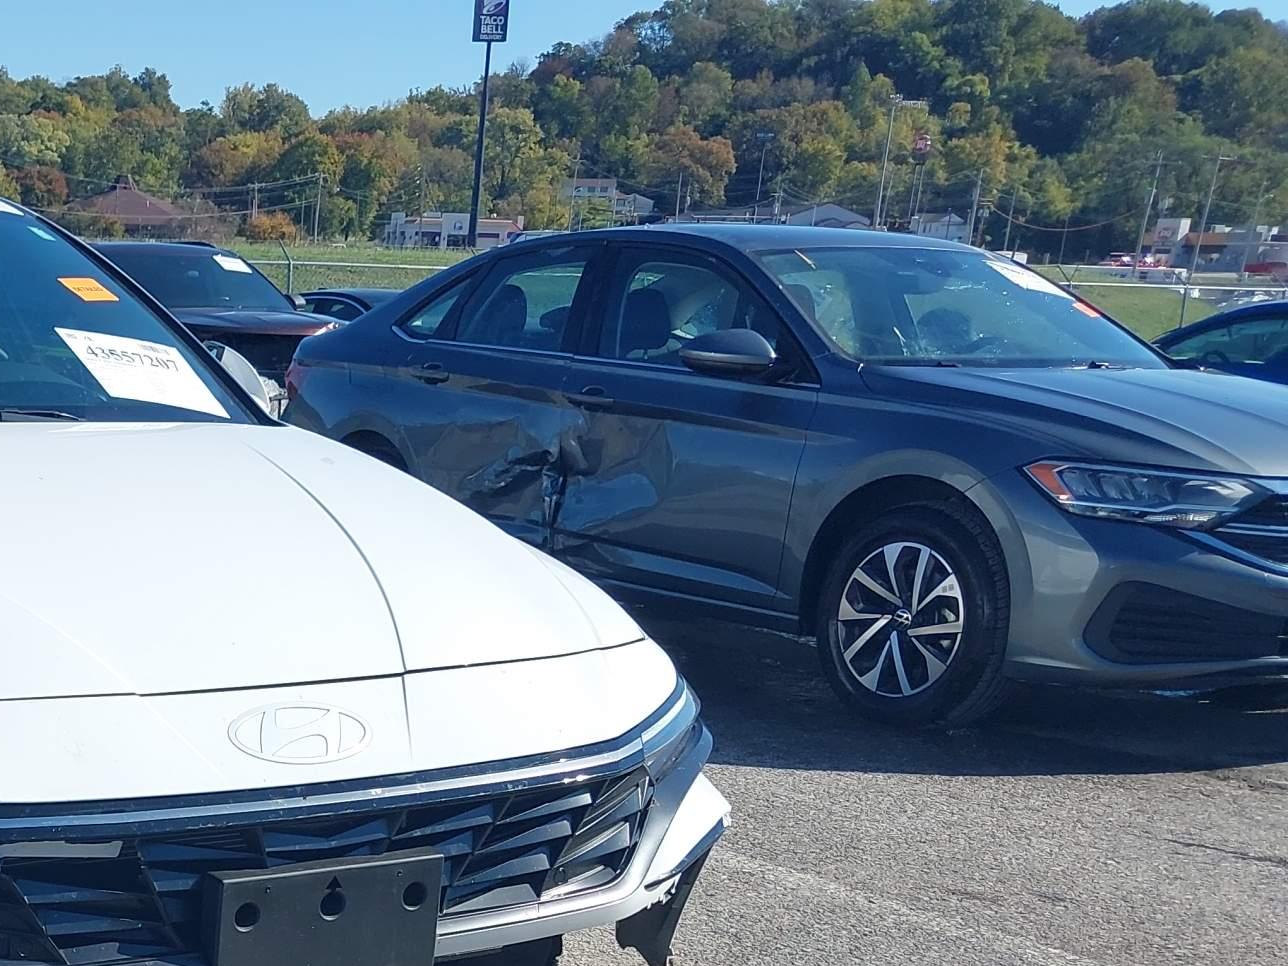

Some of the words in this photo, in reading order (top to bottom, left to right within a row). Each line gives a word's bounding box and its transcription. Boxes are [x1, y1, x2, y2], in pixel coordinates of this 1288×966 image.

[480, 16, 505, 25] TACO
[481, 25, 504, 34] BELL
[86, 345, 180, 372] 43557207
